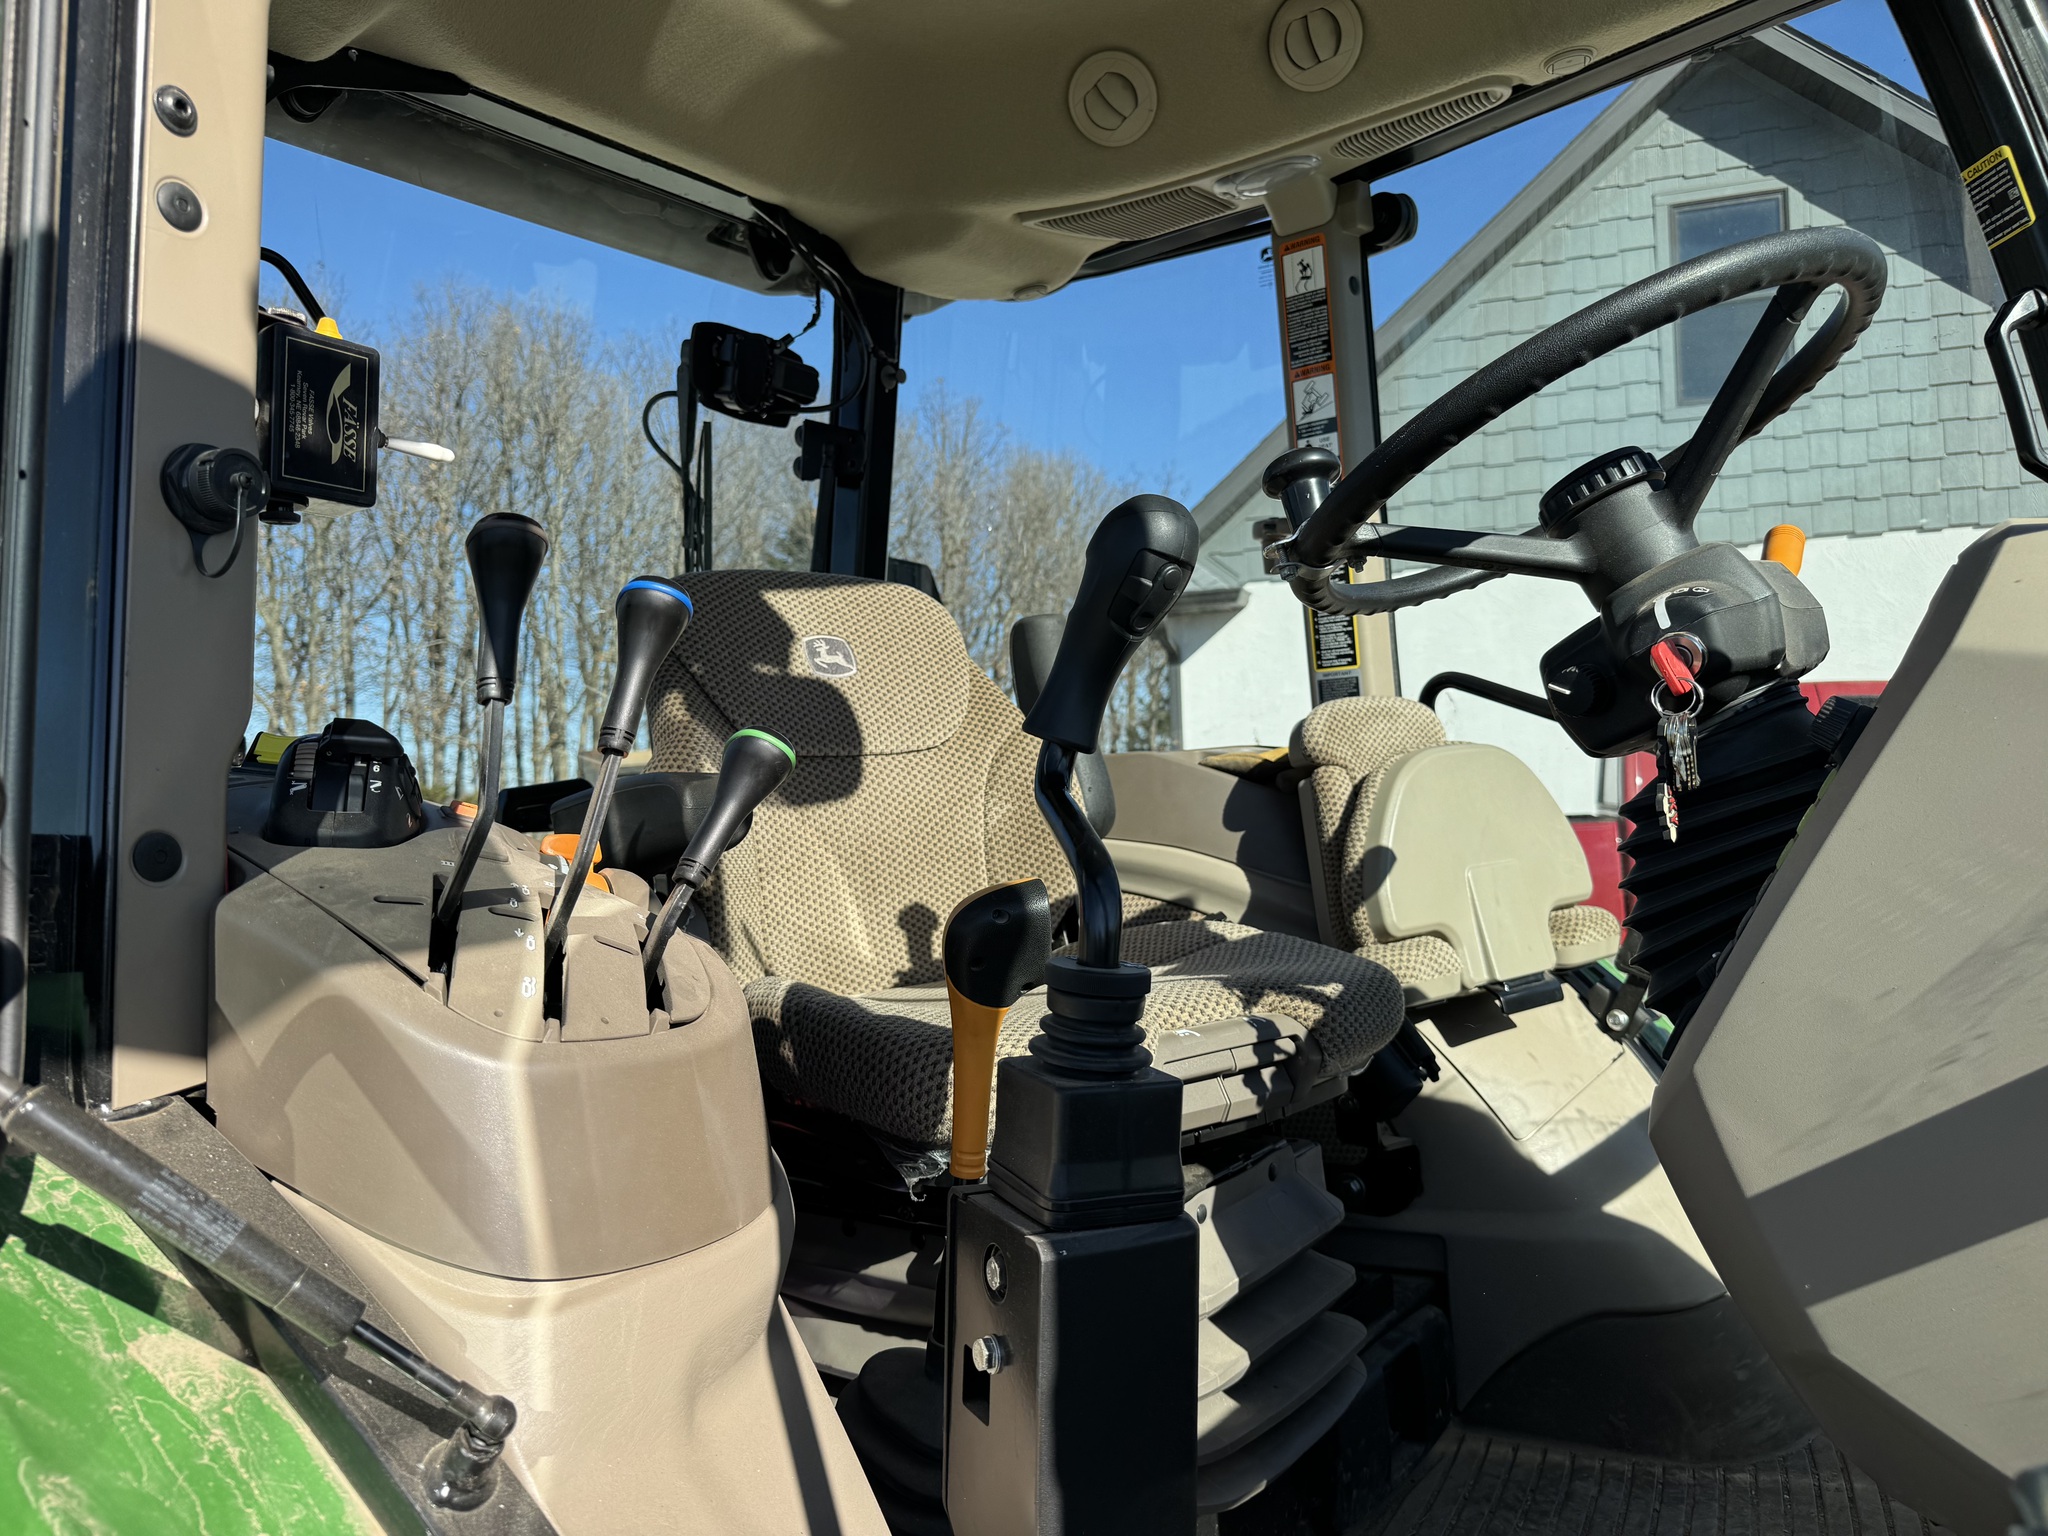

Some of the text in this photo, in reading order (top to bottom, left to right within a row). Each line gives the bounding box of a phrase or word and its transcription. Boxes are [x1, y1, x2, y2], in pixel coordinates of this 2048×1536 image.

[1966, 150, 2003, 179] CAUTION
[1290, 235, 1321, 250] WARNING
[1300, 363, 1331, 378] WARNING
[342, 396, 360, 463] FÄSSE
[1322, 670, 1352, 678] IMPORTANT
